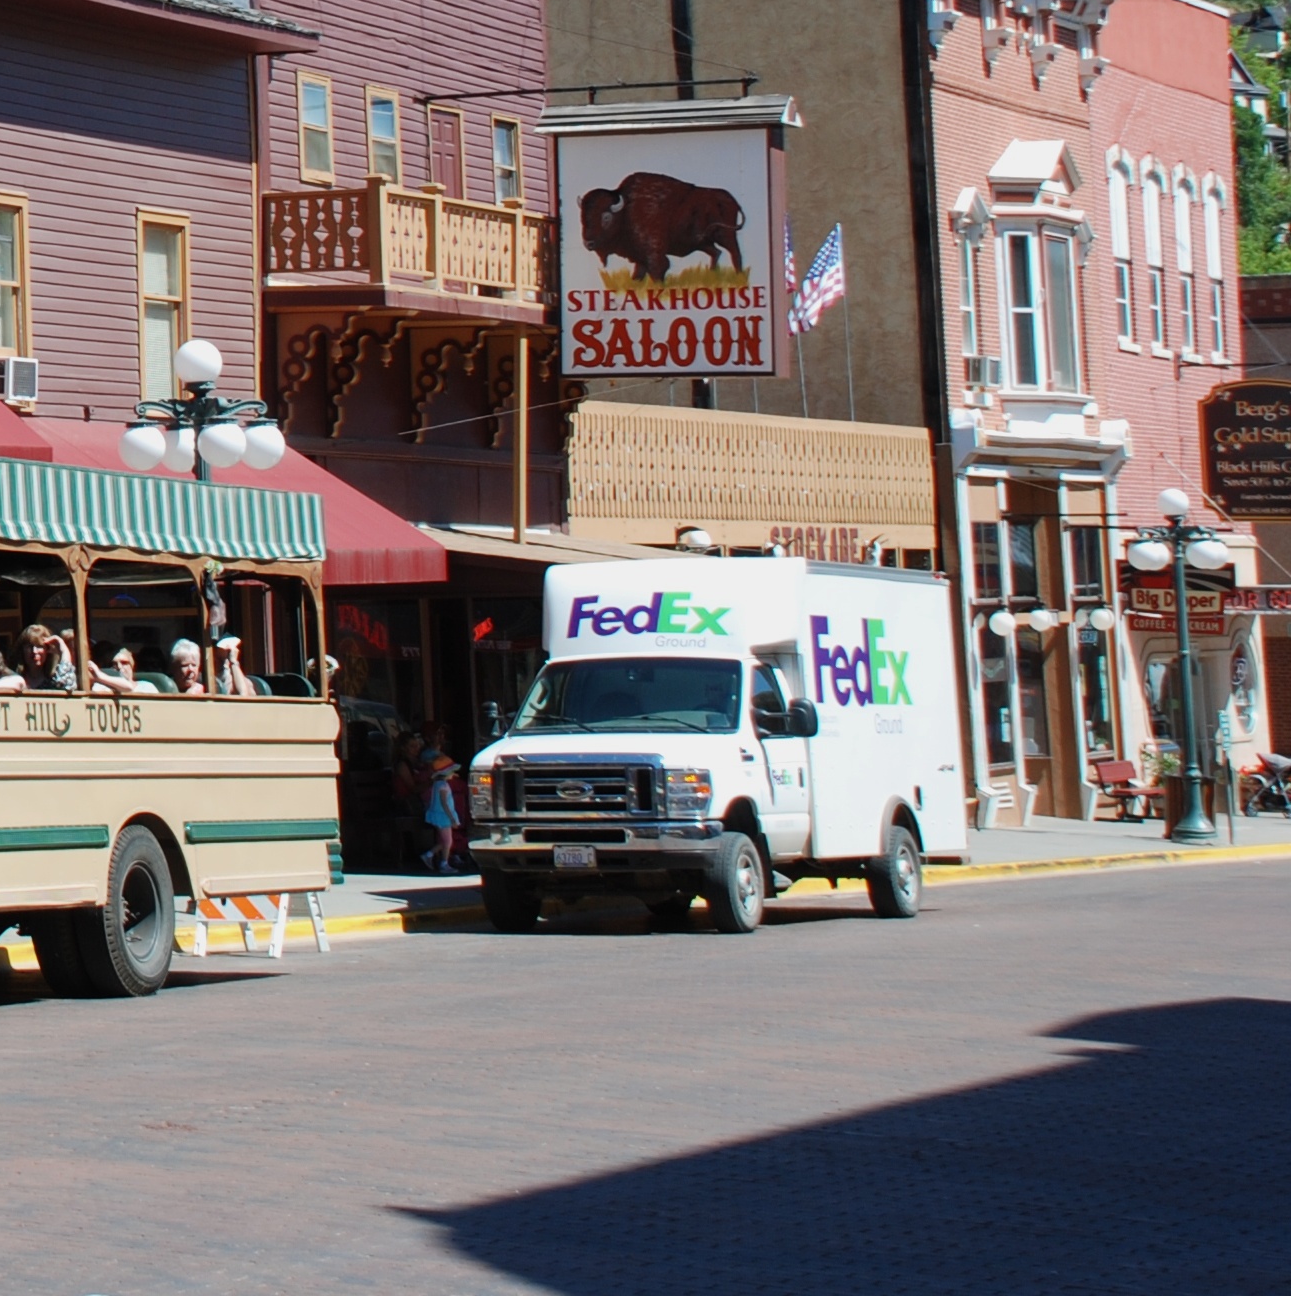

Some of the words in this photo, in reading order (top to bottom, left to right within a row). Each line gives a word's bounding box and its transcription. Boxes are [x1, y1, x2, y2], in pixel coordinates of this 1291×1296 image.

[567, 286, 767, 313] STEAKHOUSE
[571, 315, 765, 369] SALOON
[1235, 400, 1289, 422] Berg's
[1213, 427, 1259, 443] Gold
[770, 525, 861, 563] STOCKADE
[1135, 590, 1159, 608] Big
[1164, 592, 1217, 610] Dper
[566, 592, 732, 639] FedEx
[1189, 622, 1219, 632] CREAM
[654, 635, 707, 649] Ground
[809, 615, 913, 707] FedEx
[25, 702, 70, 737] HILL
[86, 703, 142, 734] TOURS
[772, 769, 793, 785] FedEx
